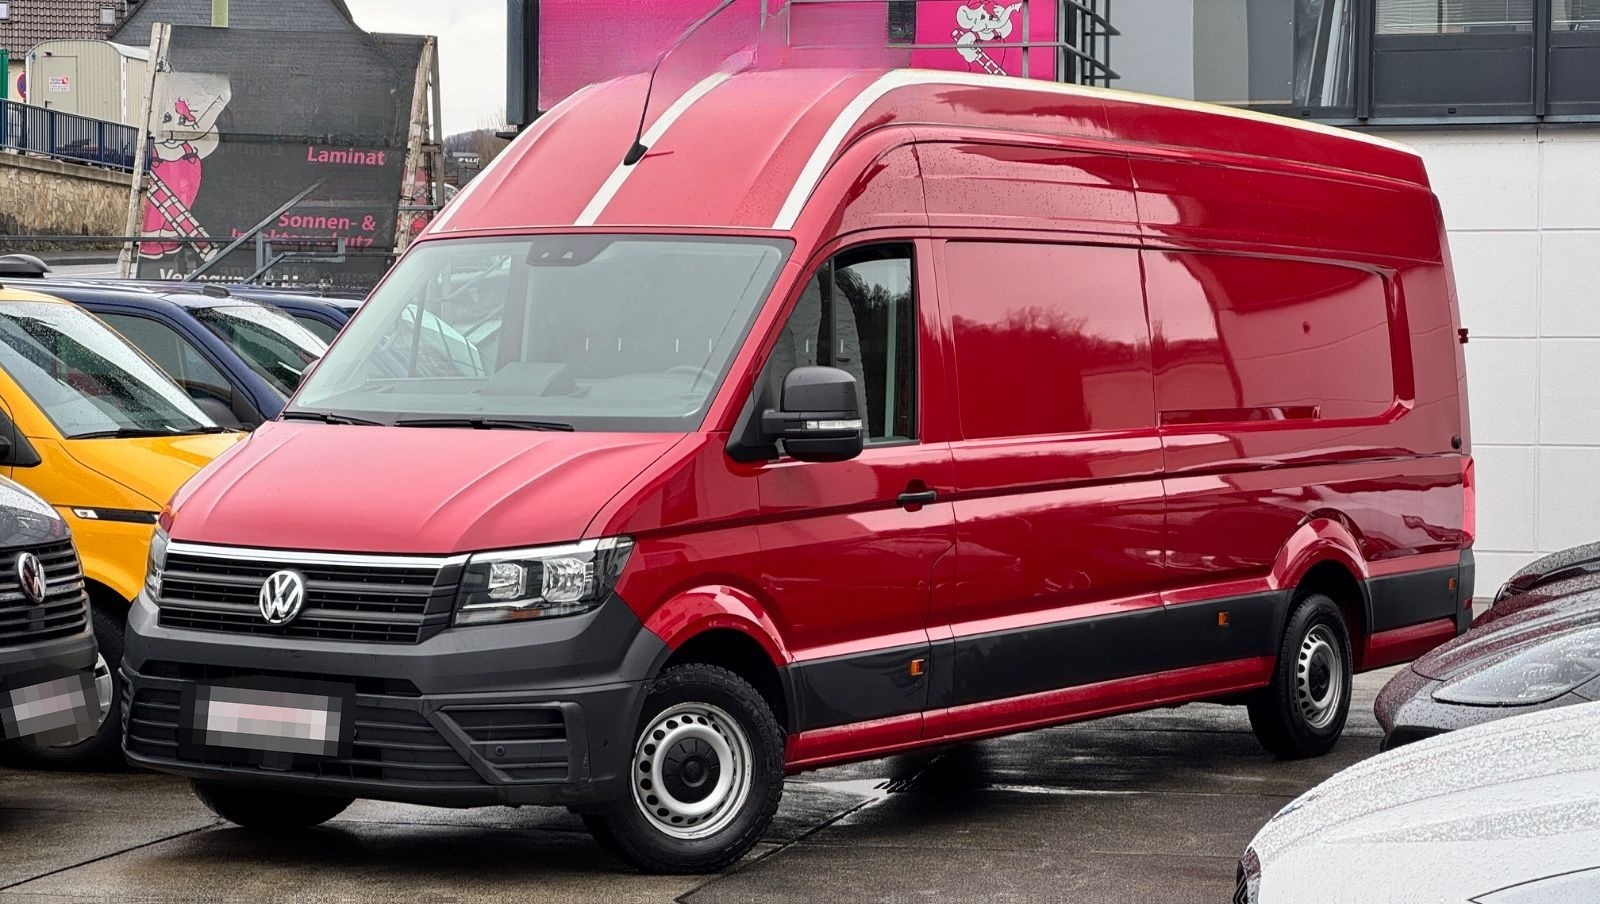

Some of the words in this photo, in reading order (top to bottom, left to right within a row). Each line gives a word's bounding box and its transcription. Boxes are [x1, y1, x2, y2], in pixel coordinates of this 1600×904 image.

[307, 146, 385, 165] Laminat
[278, 212, 358, 230] Sonnen-
[361, 215, 376, 231] &
